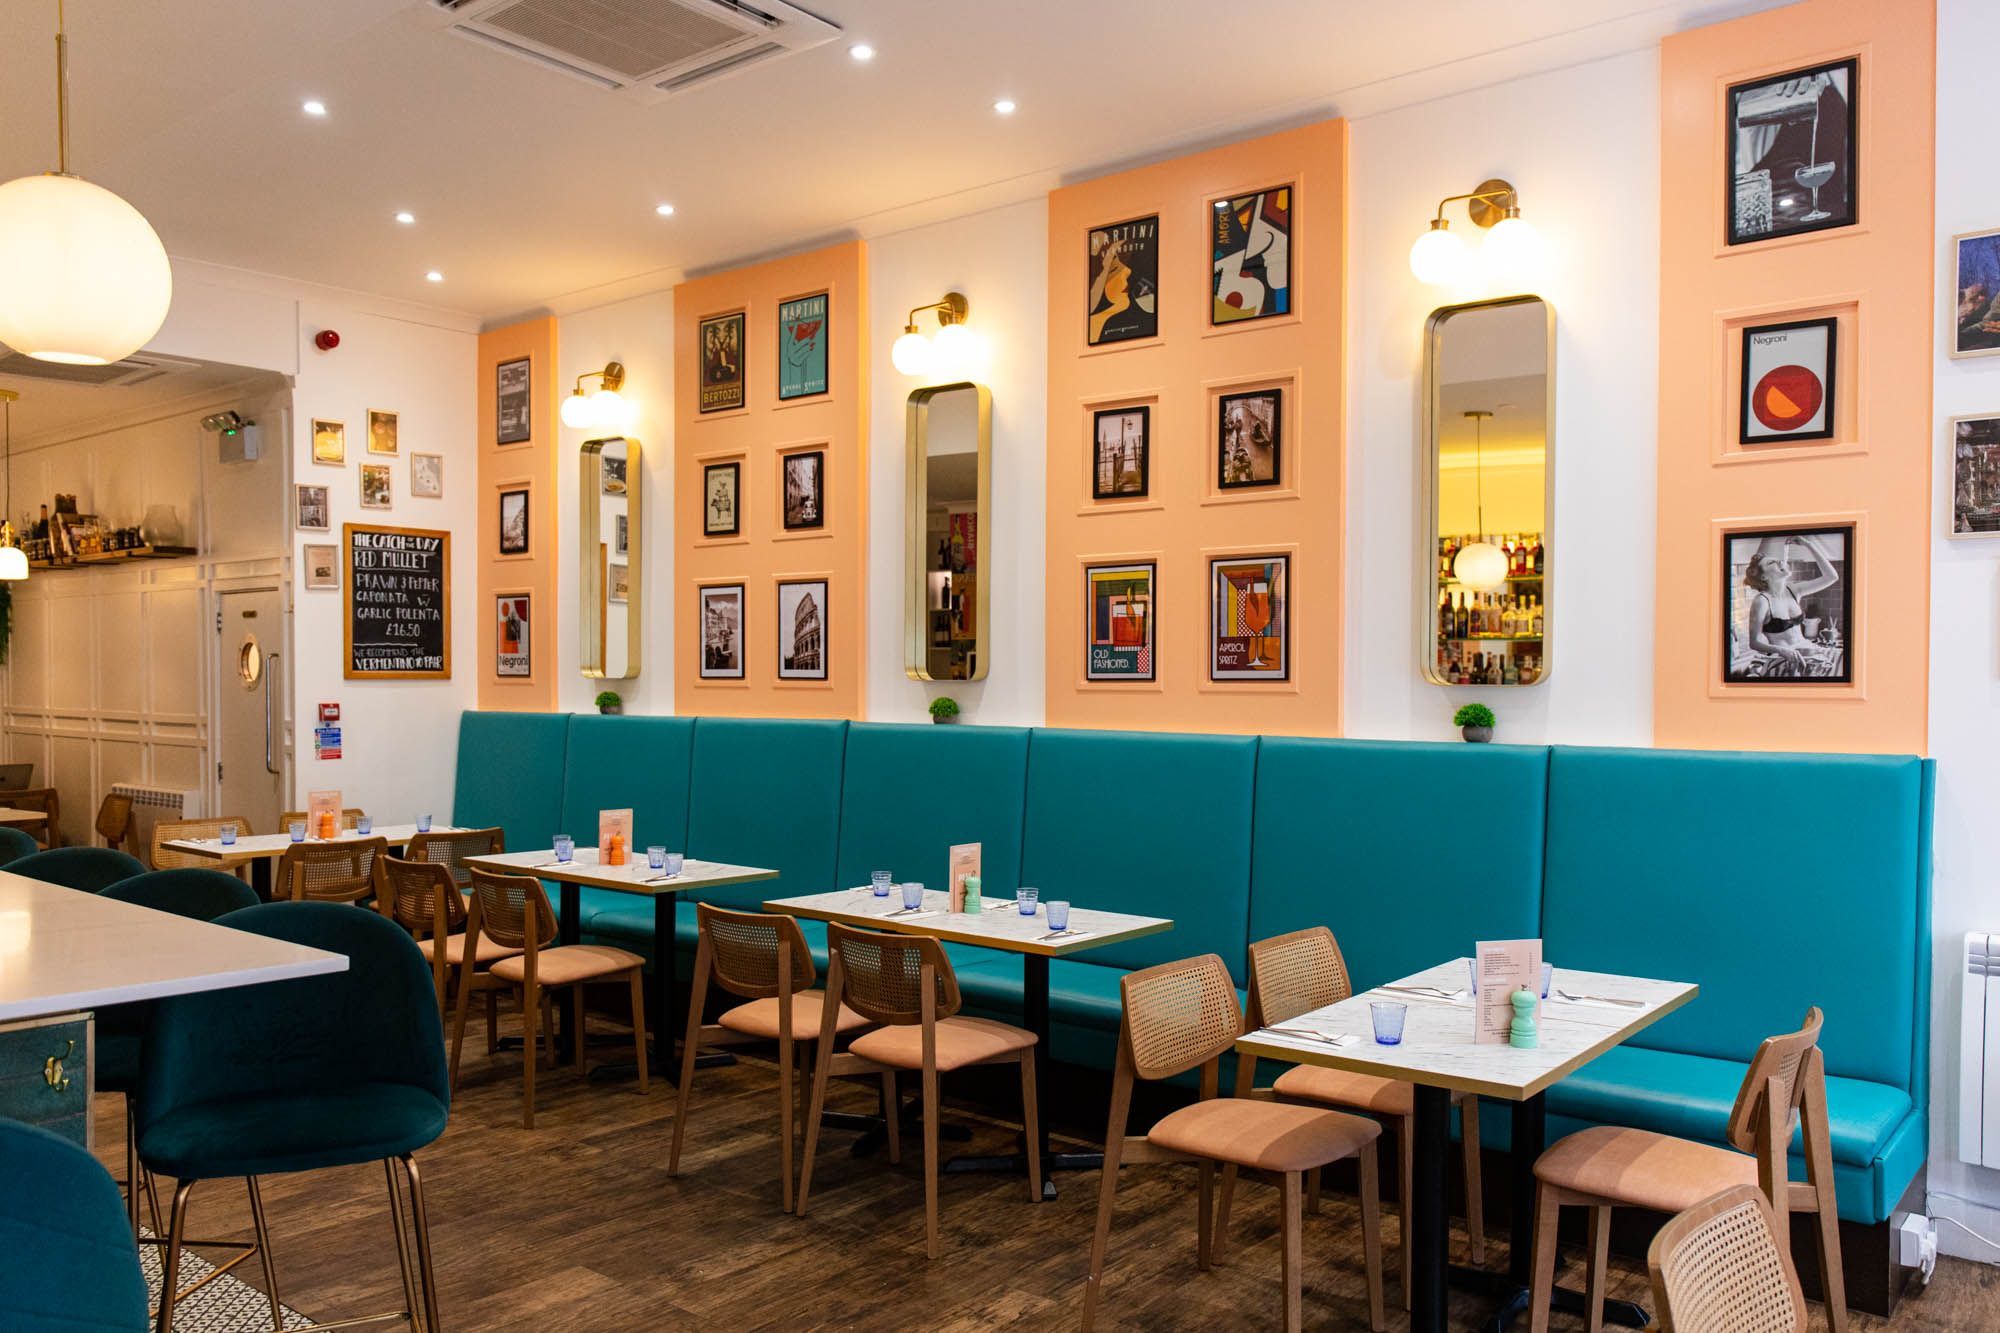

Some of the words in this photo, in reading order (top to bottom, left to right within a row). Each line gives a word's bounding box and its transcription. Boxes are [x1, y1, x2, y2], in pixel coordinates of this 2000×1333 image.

[1091, 224, 1154, 246] MARTINI
[782, 299, 824, 321] MARTINI
[1753, 331, 1788, 346] Negroni
[703, 387, 740, 403] BERTOZZI
[353, 533, 372, 546] THE
[372, 534, 406, 550] CATCH
[415, 537, 440, 551] DAY
[354, 550, 377, 568] RED
[382, 551, 429, 569] MULLET
[356, 573, 397, 589] PRAWN
[408, 576, 440, 592] PEPPER
[356, 590, 410, 604] CAPONATA
[357, 607, 392, 620] GARLIC
[396, 607, 440, 621] POLENTA
[386, 622, 421, 637] £16.50
[1093, 649, 1109, 659] OLD
[1219, 642, 1246, 653] APEROL
[355, 657, 415, 671] VERMENTINO
[424, 655, 443, 670] PAIR
[499, 655, 529, 668] Negroni
[1219, 655, 1238, 665] SPRITZ
